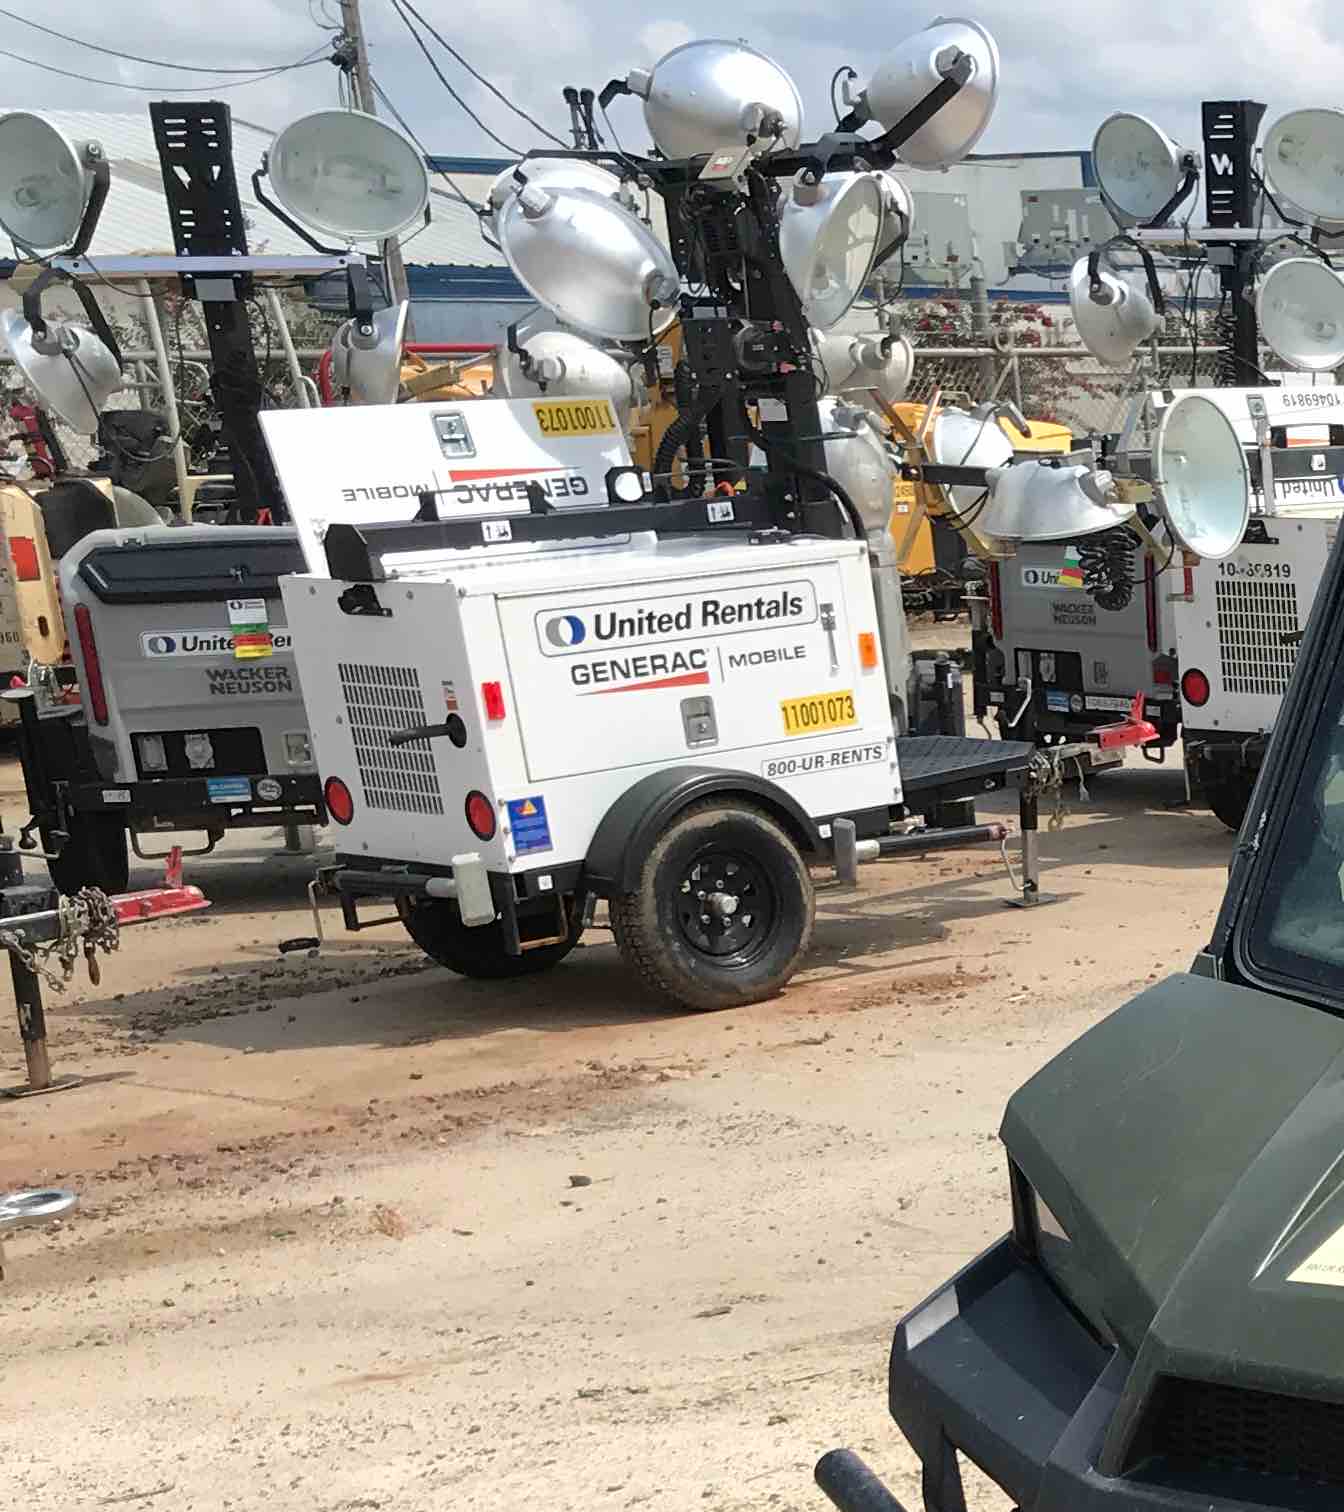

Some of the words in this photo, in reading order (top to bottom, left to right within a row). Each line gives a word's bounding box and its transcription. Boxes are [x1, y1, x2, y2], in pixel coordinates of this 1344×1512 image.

[536, 405, 616, 432] 11001073
[341, 483, 430, 503] MOBILE
[1283, 479, 1336, 499] United
[594, 602, 692, 641] United
[702, 592, 803, 627] Rentals
[181, 635, 235, 652] Unite
[206, 666, 290, 683] WACKER
[571, 648, 708, 686] GENERAC
[729, 645, 807, 668] MOBILE
[210, 679, 293, 695] NEUSON
[782, 695, 856, 731] 11001073
[767, 745, 883, 778] 800-UR-RENTS
